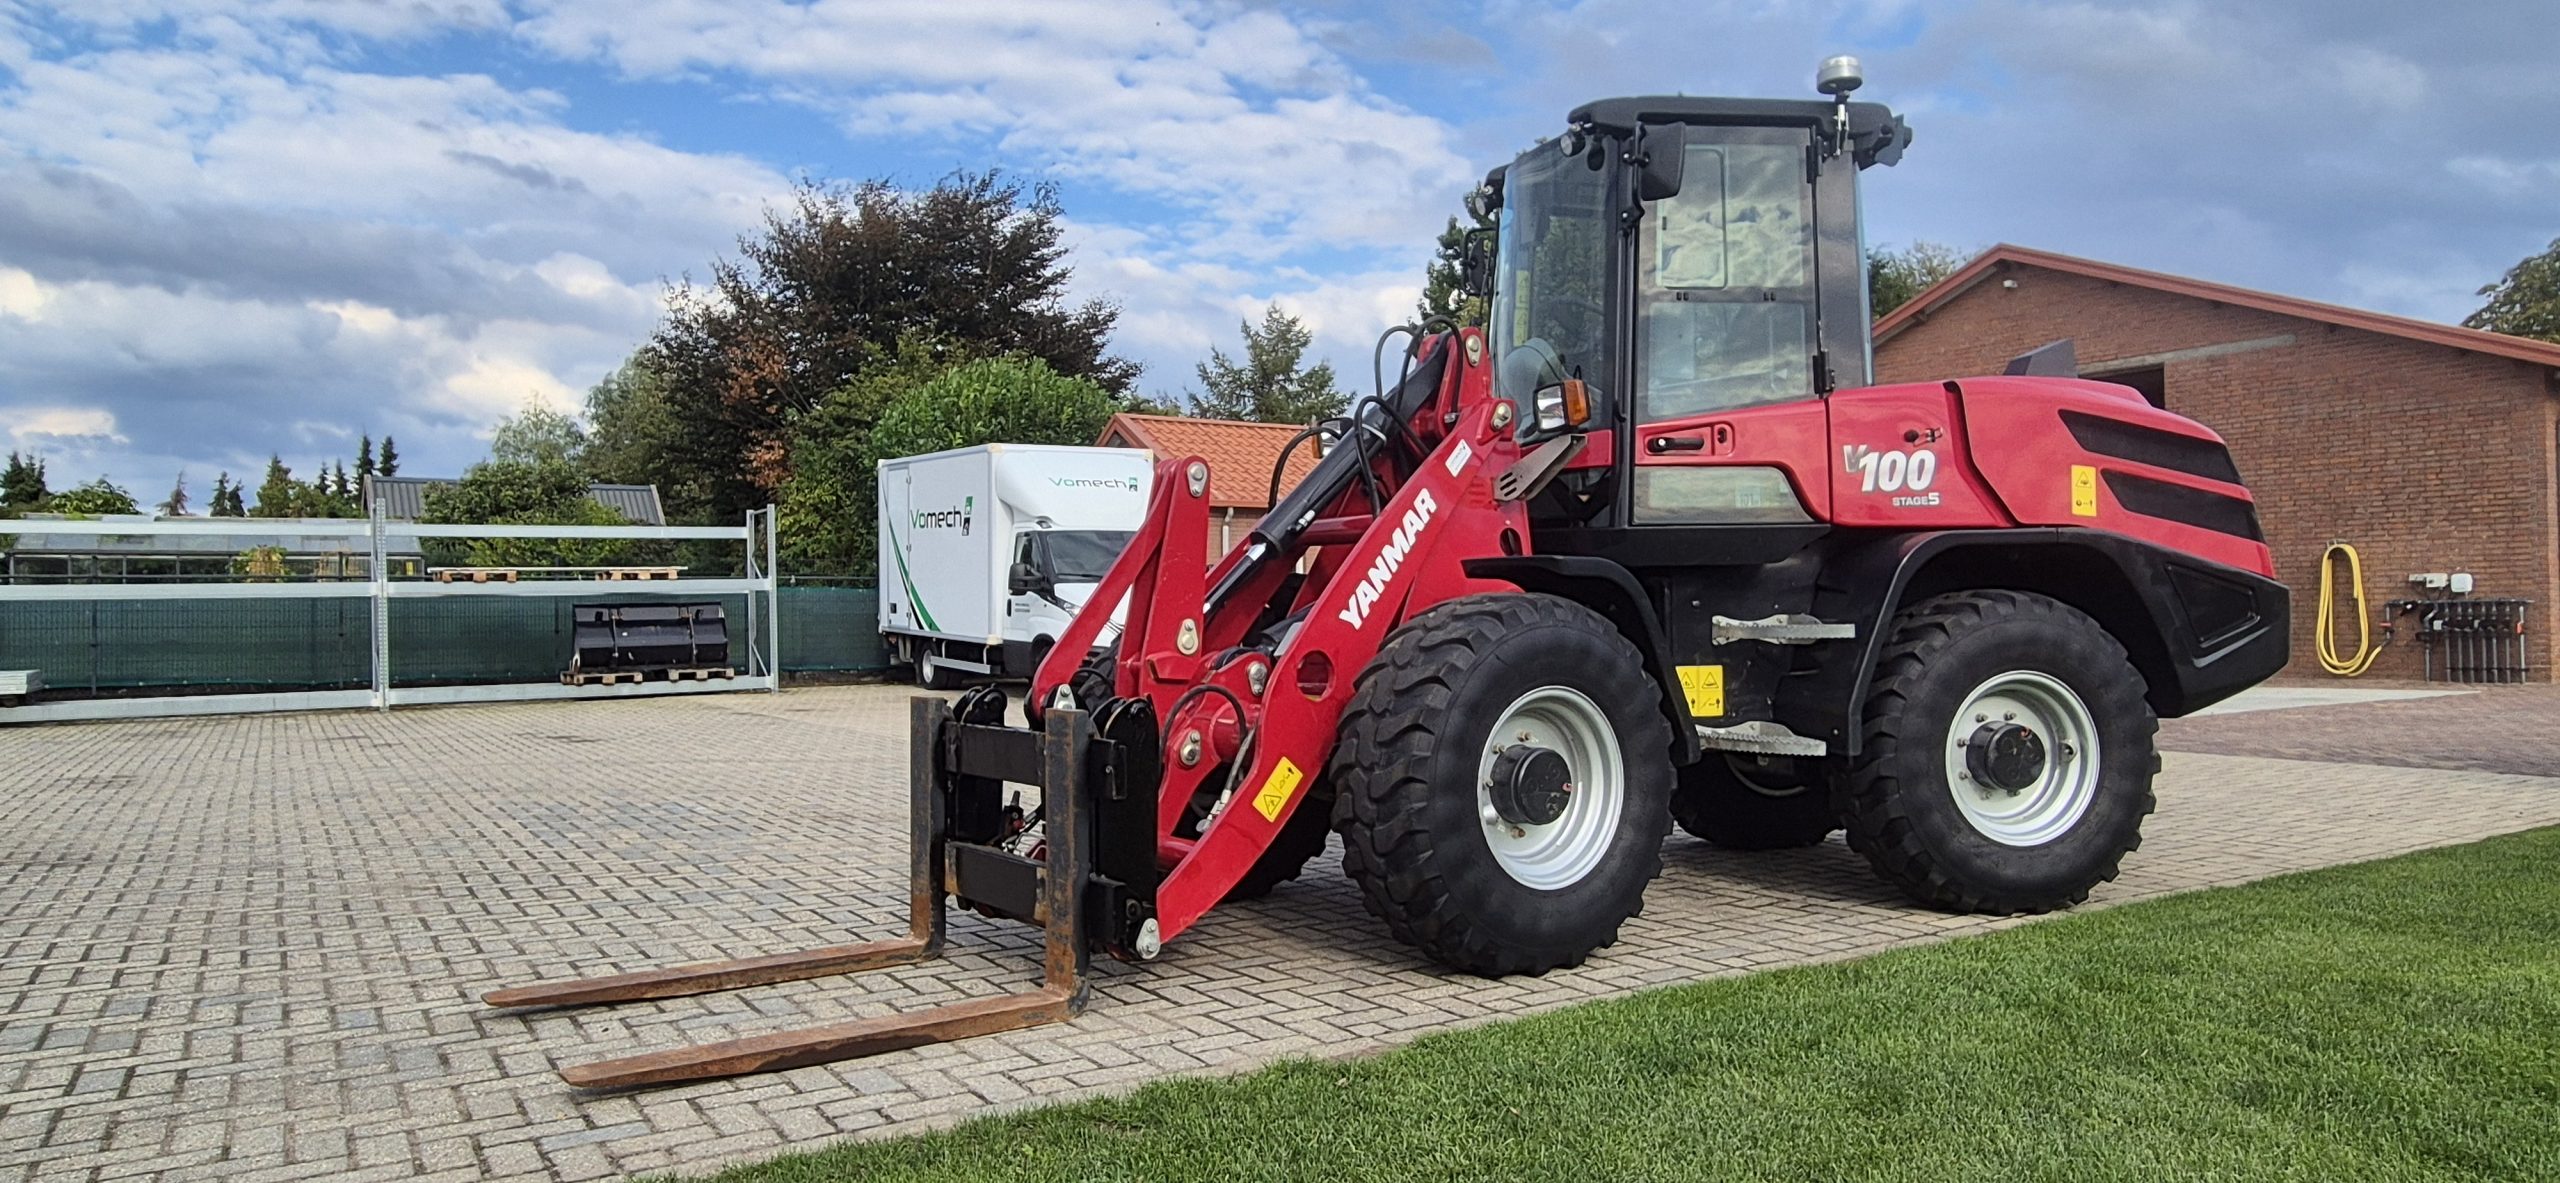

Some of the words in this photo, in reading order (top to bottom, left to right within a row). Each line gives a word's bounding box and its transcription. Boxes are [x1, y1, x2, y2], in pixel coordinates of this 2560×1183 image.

[1048, 476, 1127, 488] Vomech
[910, 505, 962, 529] Vomech
[1339, 488, 1437, 630] YANMAR
